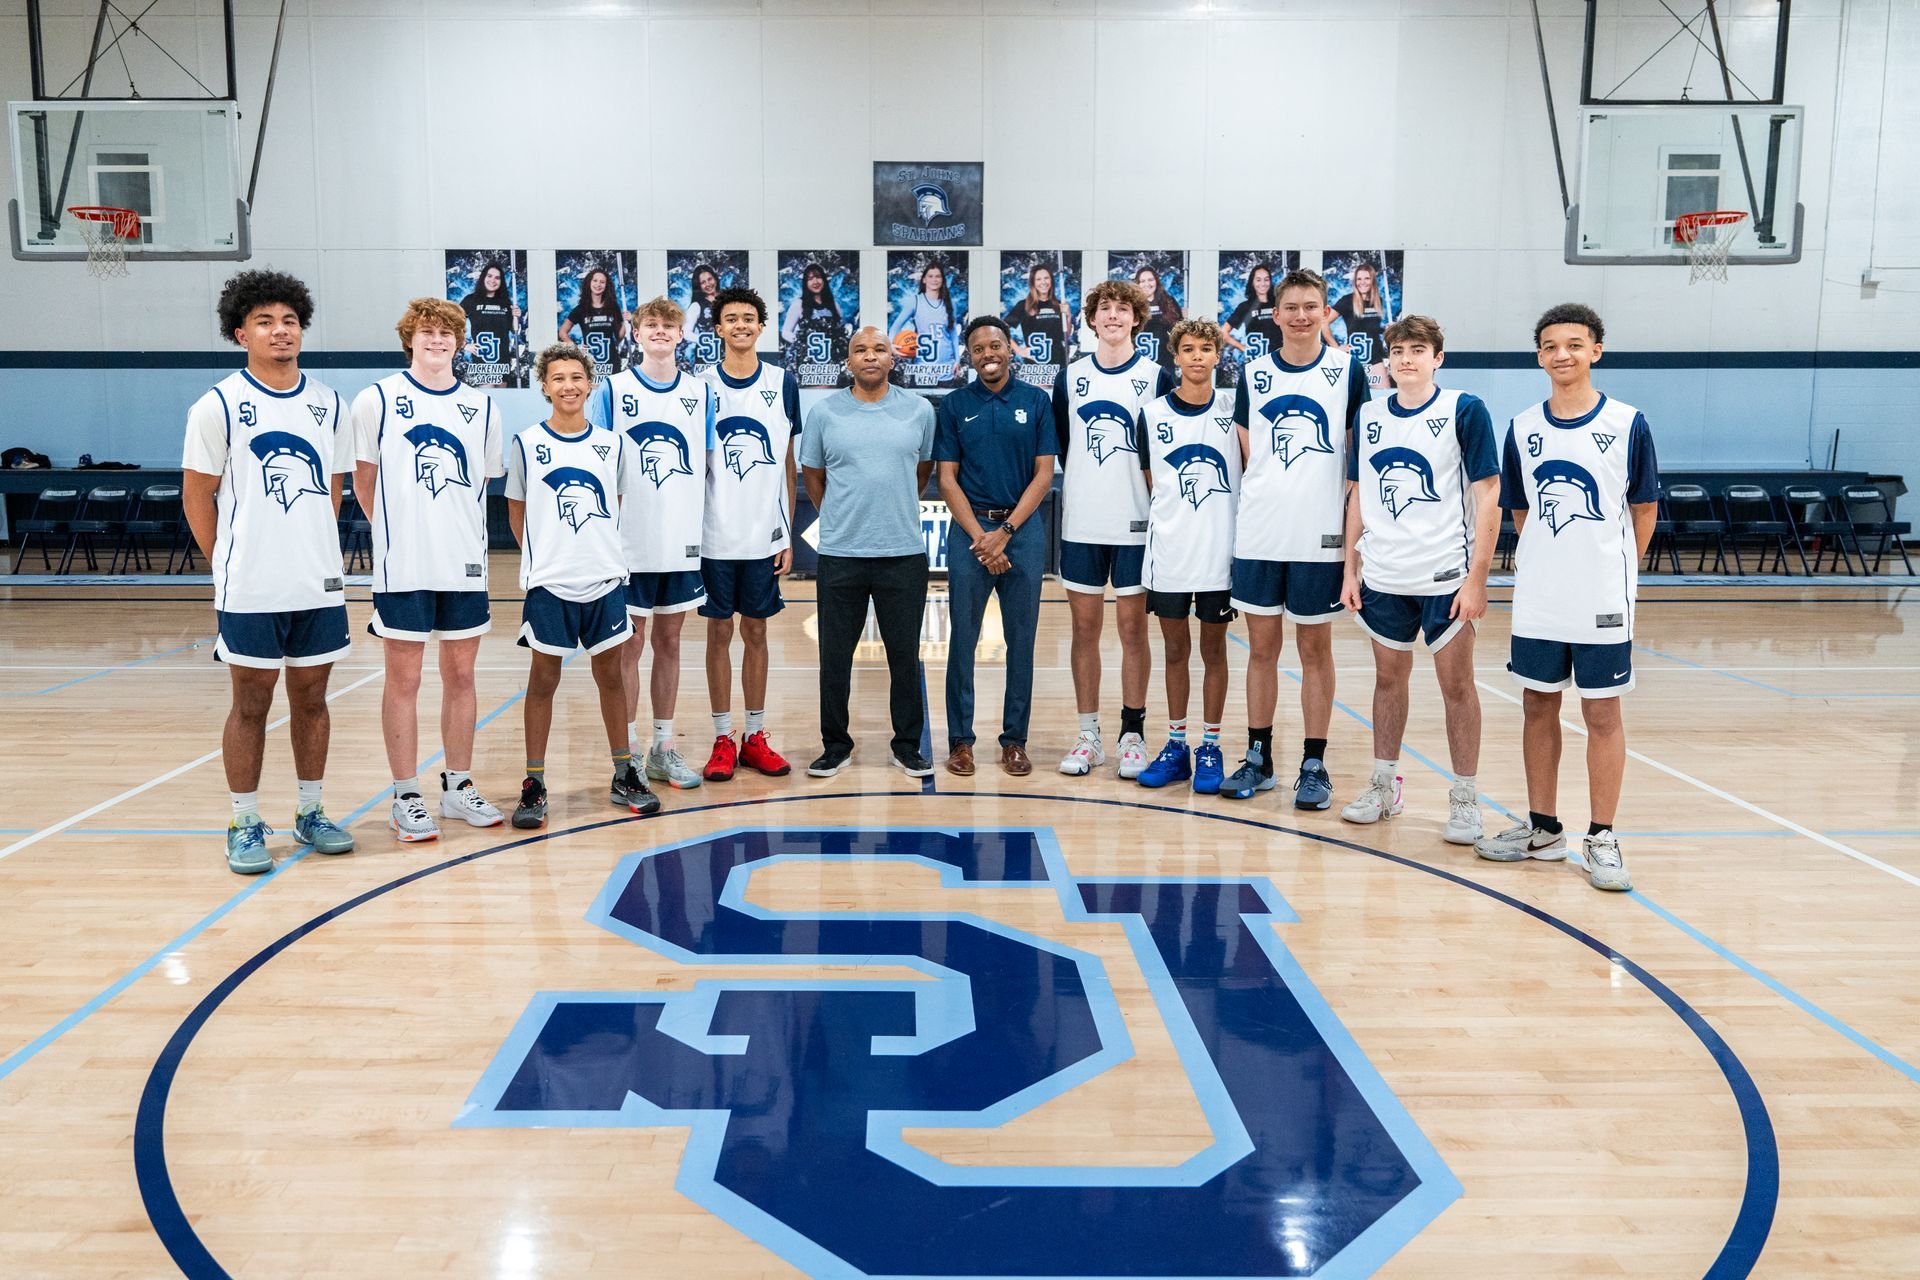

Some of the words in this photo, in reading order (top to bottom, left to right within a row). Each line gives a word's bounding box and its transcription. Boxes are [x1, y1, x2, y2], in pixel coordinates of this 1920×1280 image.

[892, 222, 966, 241] SPARTANS
[476, 332, 500, 364] SJ
[586, 332, 611, 364] SJ
[697, 332, 721, 364] SJ
[807, 332, 831, 364] SJ
[917, 333, 939, 363] SJ
[1028, 332, 1052, 364] SJ
[1350, 332, 1373, 364] SJ
[467, 363, 510, 374] MCKENNA
[476, 374, 503, 384] SACHS
[595, 364, 613, 374] RAH
[799, 363, 840, 374] CORDELIA
[801, 374, 838, 385] PAINTER
[904, 364, 929, 375] MARY
[930, 364, 951, 374] KATE
[916, 374, 939, 385] KENT
[1020, 364, 1060, 374] ADDISON
[1076, 377, 1091, 397] SJ
[1254, 370, 1273, 394] SJ
[239, 401, 257, 427] SJ
[396, 395, 414, 419] SJ
[622, 394, 639, 417] SJ
[1157, 422, 1174, 444] SJ
[1367, 421, 1383, 444] SJ
[536, 444, 552, 465] SJ
[1527, 432, 1544, 457] SJ
[451, 825, 1466, 1280] SJ
